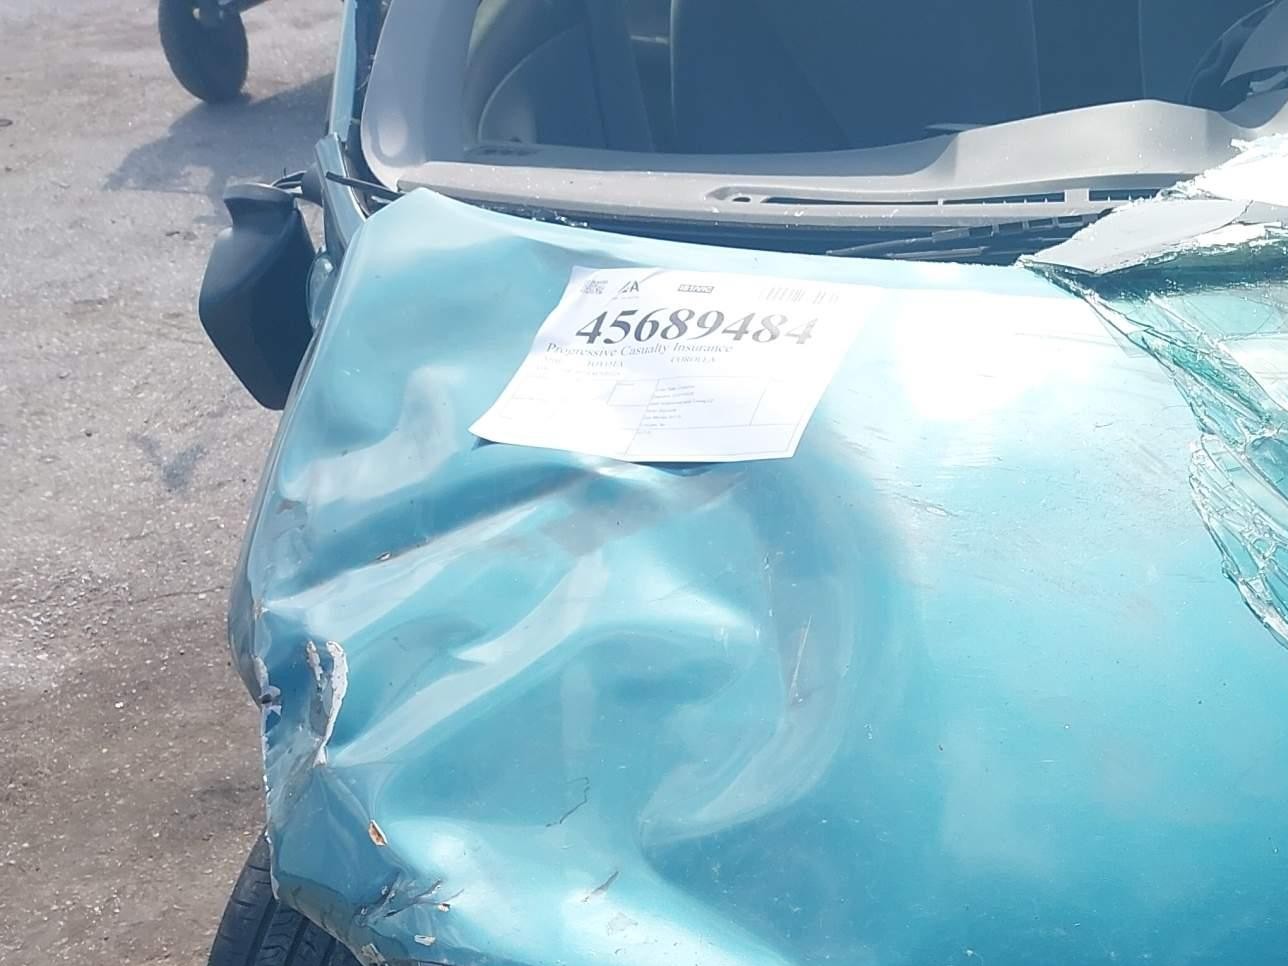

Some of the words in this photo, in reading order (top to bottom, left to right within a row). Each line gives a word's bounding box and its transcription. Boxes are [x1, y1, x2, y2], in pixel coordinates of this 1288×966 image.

[575, 308, 819, 345] 45689484
[546, 342, 618, 358] Progressive
[620, 343, 670, 357] Casualty
[673, 342, 734, 354] Insurance
